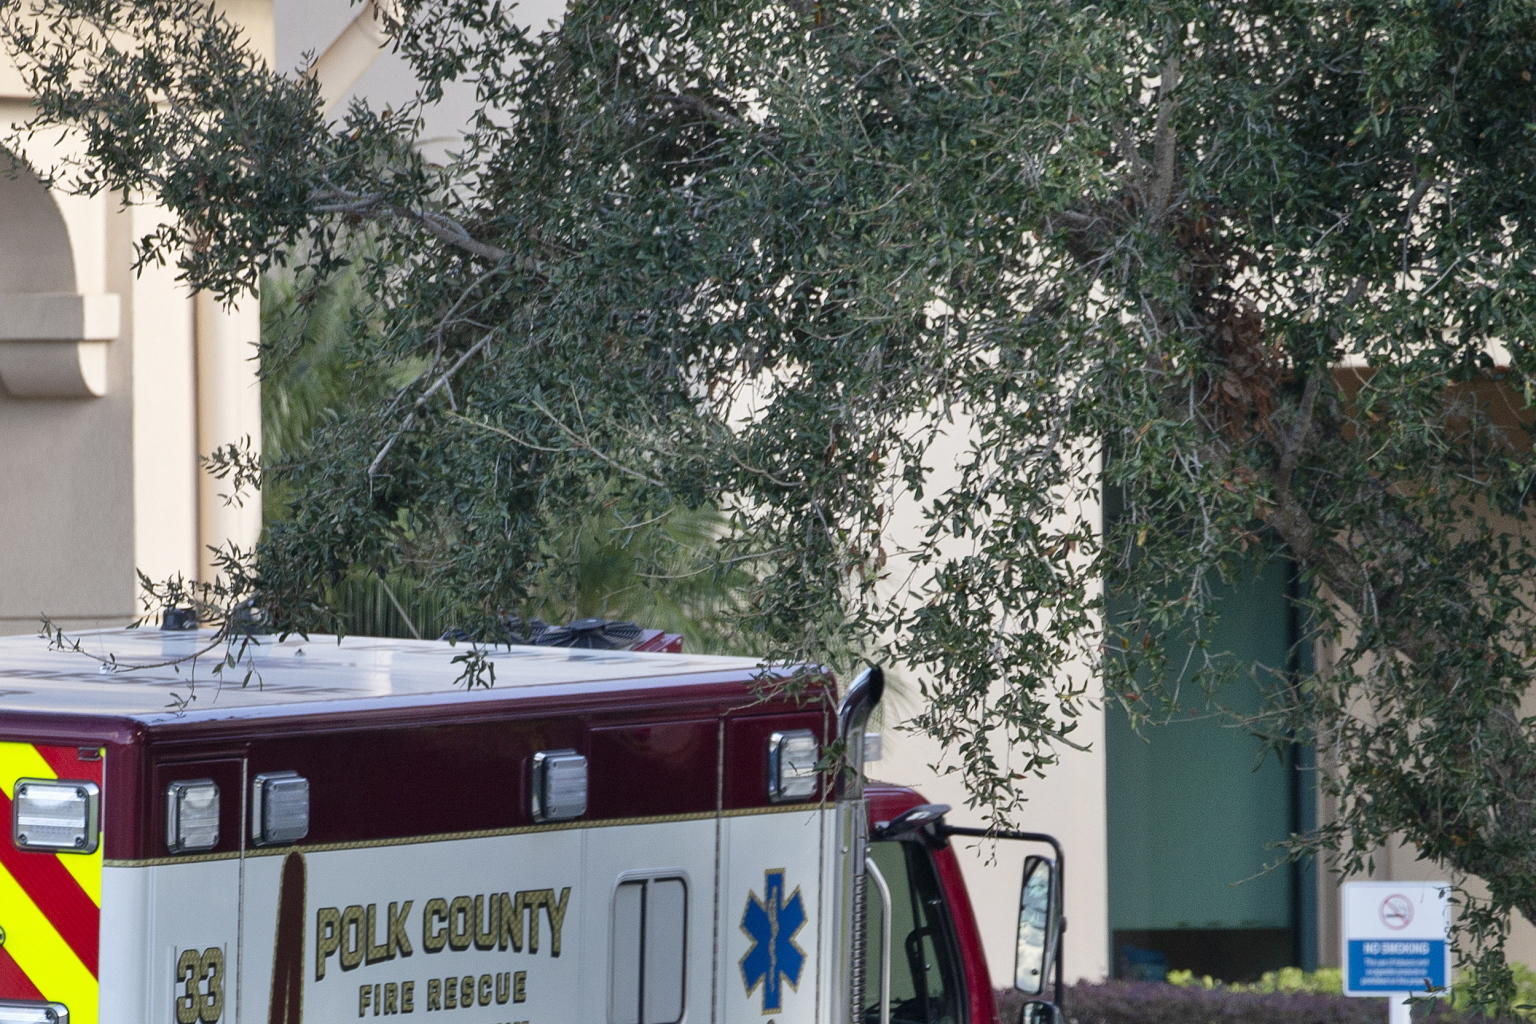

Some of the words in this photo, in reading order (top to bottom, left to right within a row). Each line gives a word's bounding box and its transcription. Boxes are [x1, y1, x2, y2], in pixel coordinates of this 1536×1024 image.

[315, 900, 414, 982] POLK
[422, 886, 571, 958] COUNTY
[358, 981, 415, 1017] FIRE
[427, 970, 527, 1012] RESCUE
